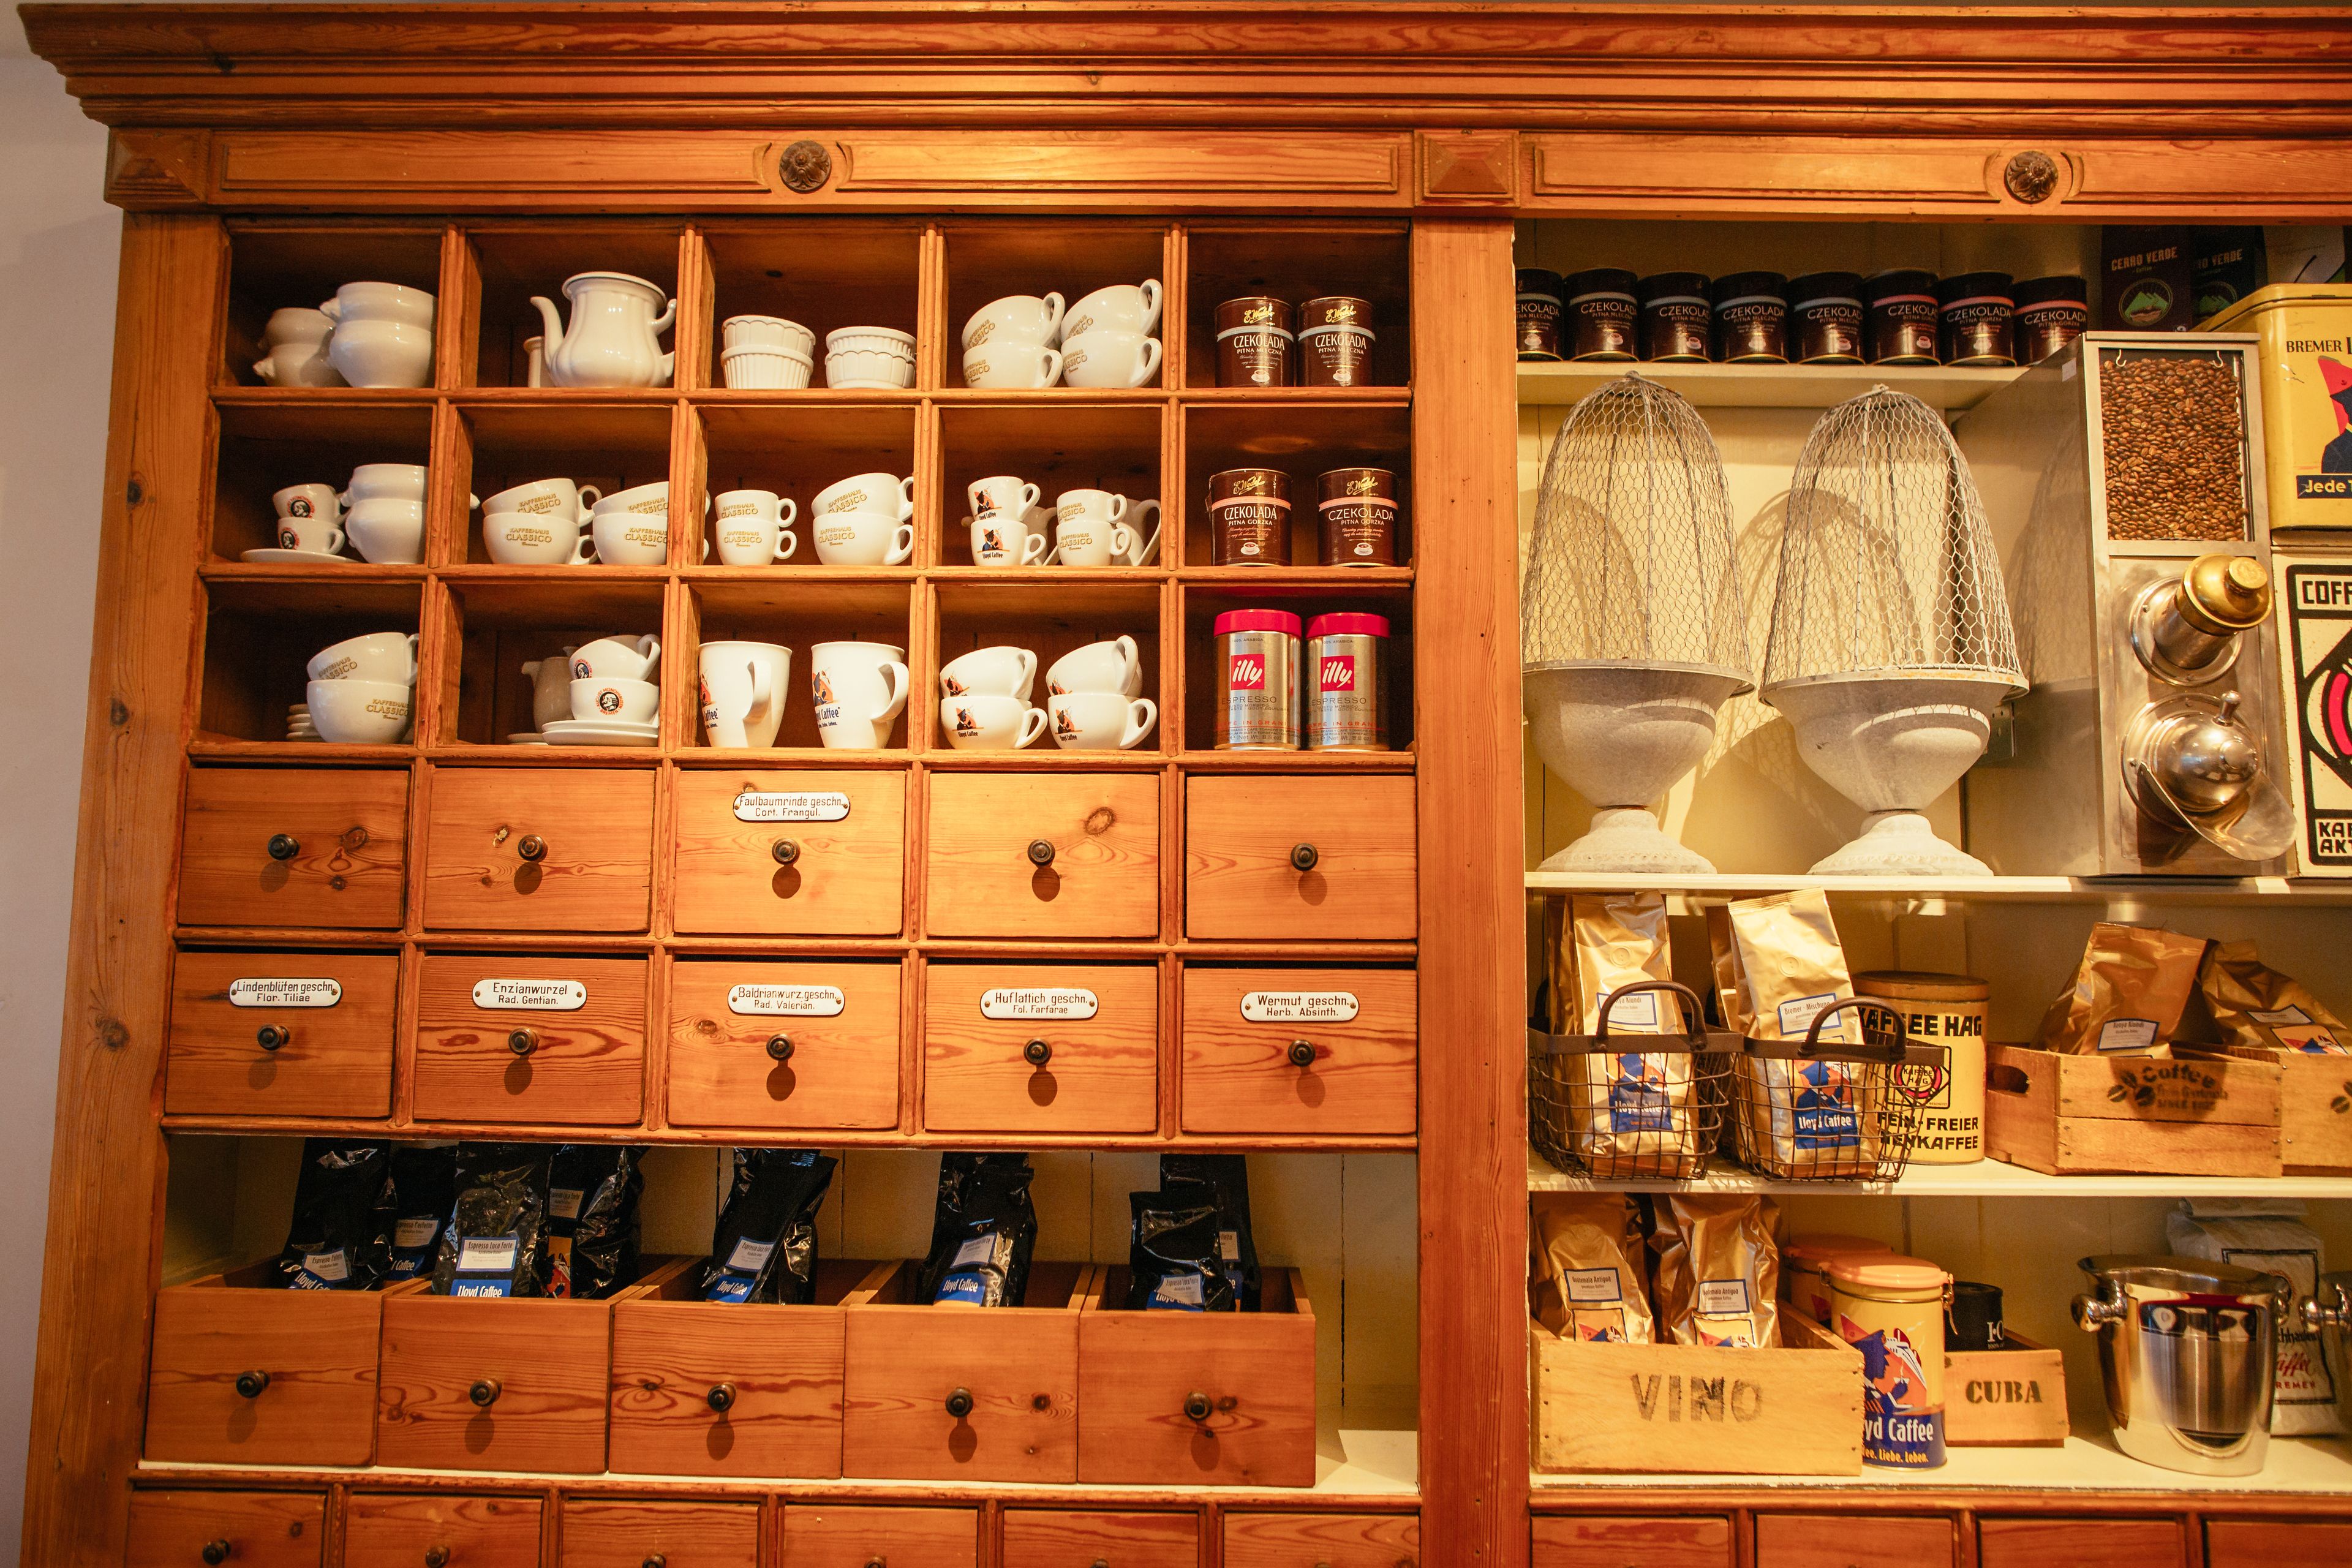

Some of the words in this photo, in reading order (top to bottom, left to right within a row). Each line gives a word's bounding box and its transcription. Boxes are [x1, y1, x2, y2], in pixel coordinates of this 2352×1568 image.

[2146, 246, 2177, 263] VERDE
[1516, 303, 1559, 316] EKOLADA
[1724, 306, 1784, 320] CZEKOLADA
[1947, 306, 2011, 322] CZEKOLADA
[2025, 310, 2086, 325] CZEKOLADA
[1234, 334, 1285, 350] CZEKOLADA
[1316, 334, 1366, 350] CZEKOLADA
[2286, 339, 2343, 353] BREMER
[2305, 480, 2346, 493] Jede
[519, 493, 557, 507] KAFFEEHAUS
[628, 497, 666, 511] KAFFEEHAUS
[828, 489, 862, 508] KAFFEEHAUS
[721, 508, 758, 518] CLASSICO
[1224, 506, 1277, 520] CZEKOLADA
[1329, 508, 1394, 522] CZEKOLADA
[506, 533, 552, 543] CLASSICO
[818, 532, 855, 544] CLASSICO
[1060, 538, 1093, 548] CLASSICO
[1232, 659, 1263, 687] illy
[1322, 661, 1352, 688] illy
[372, 699, 408, 707] KAFFEEHAU
[1221, 696, 1276, 705] ESPRESSO
[1311, 697, 1366, 706] ESPRESSO
[821, 708, 839, 720] Caffee
[739, 796, 807, 807] Faulbaumrinde
[810, 796, 844, 809] geschn.
[755, 808, 778, 816] Cort.
[782, 807, 820, 819] Frangul.
[236, 981, 298, 992] Lindenblüten
[493, 982, 568, 994] Enzianwurzel
[257, 993, 280, 1001] Flor.
[284, 993, 310, 1001] Tiliae
[522, 995, 558, 1005] Gentian.
[995, 992, 1046, 1003] Huflattich
[1051, 993, 1088, 1006] geschn.
[1257, 995, 1302, 1006] Wermut
[1308, 995, 1349, 1008] geschn.
[754, 1000, 772, 1009] Rad.
[777, 1000, 815, 1009] Valerian.
[1013, 1005, 1027, 1014] Fol.
[1031, 1005, 1068, 1014] Farfarae
[1267, 1008, 1293, 1017] Herb.
[1299, 1008, 1338, 1017] Absinth.
[1944, 1016, 1981, 1036] HAG
[1798, 1115, 1823, 1131] Lloyd
[1823, 1114, 1852, 1128] Caffee
[468, 1242, 489, 1250] Espresso
[396, 1259, 415, 1271] Caffee
[295, 1272, 318, 1289] Lloyd
[717, 1280, 735, 1293] Lloyd
[943, 1279, 959, 1292] Lloyd
[959, 1278, 978, 1292] Caffee
[480, 1286, 502, 1297] Caffee
[1629, 1373, 1763, 1423] VINO
[1965, 1380, 2043, 1404] CUBA
[1889, 1418, 1934, 1442] Caffee
[1879, 1449, 1904, 1464] Liebe.
[1905, 1450, 1929, 1464] Leben.
